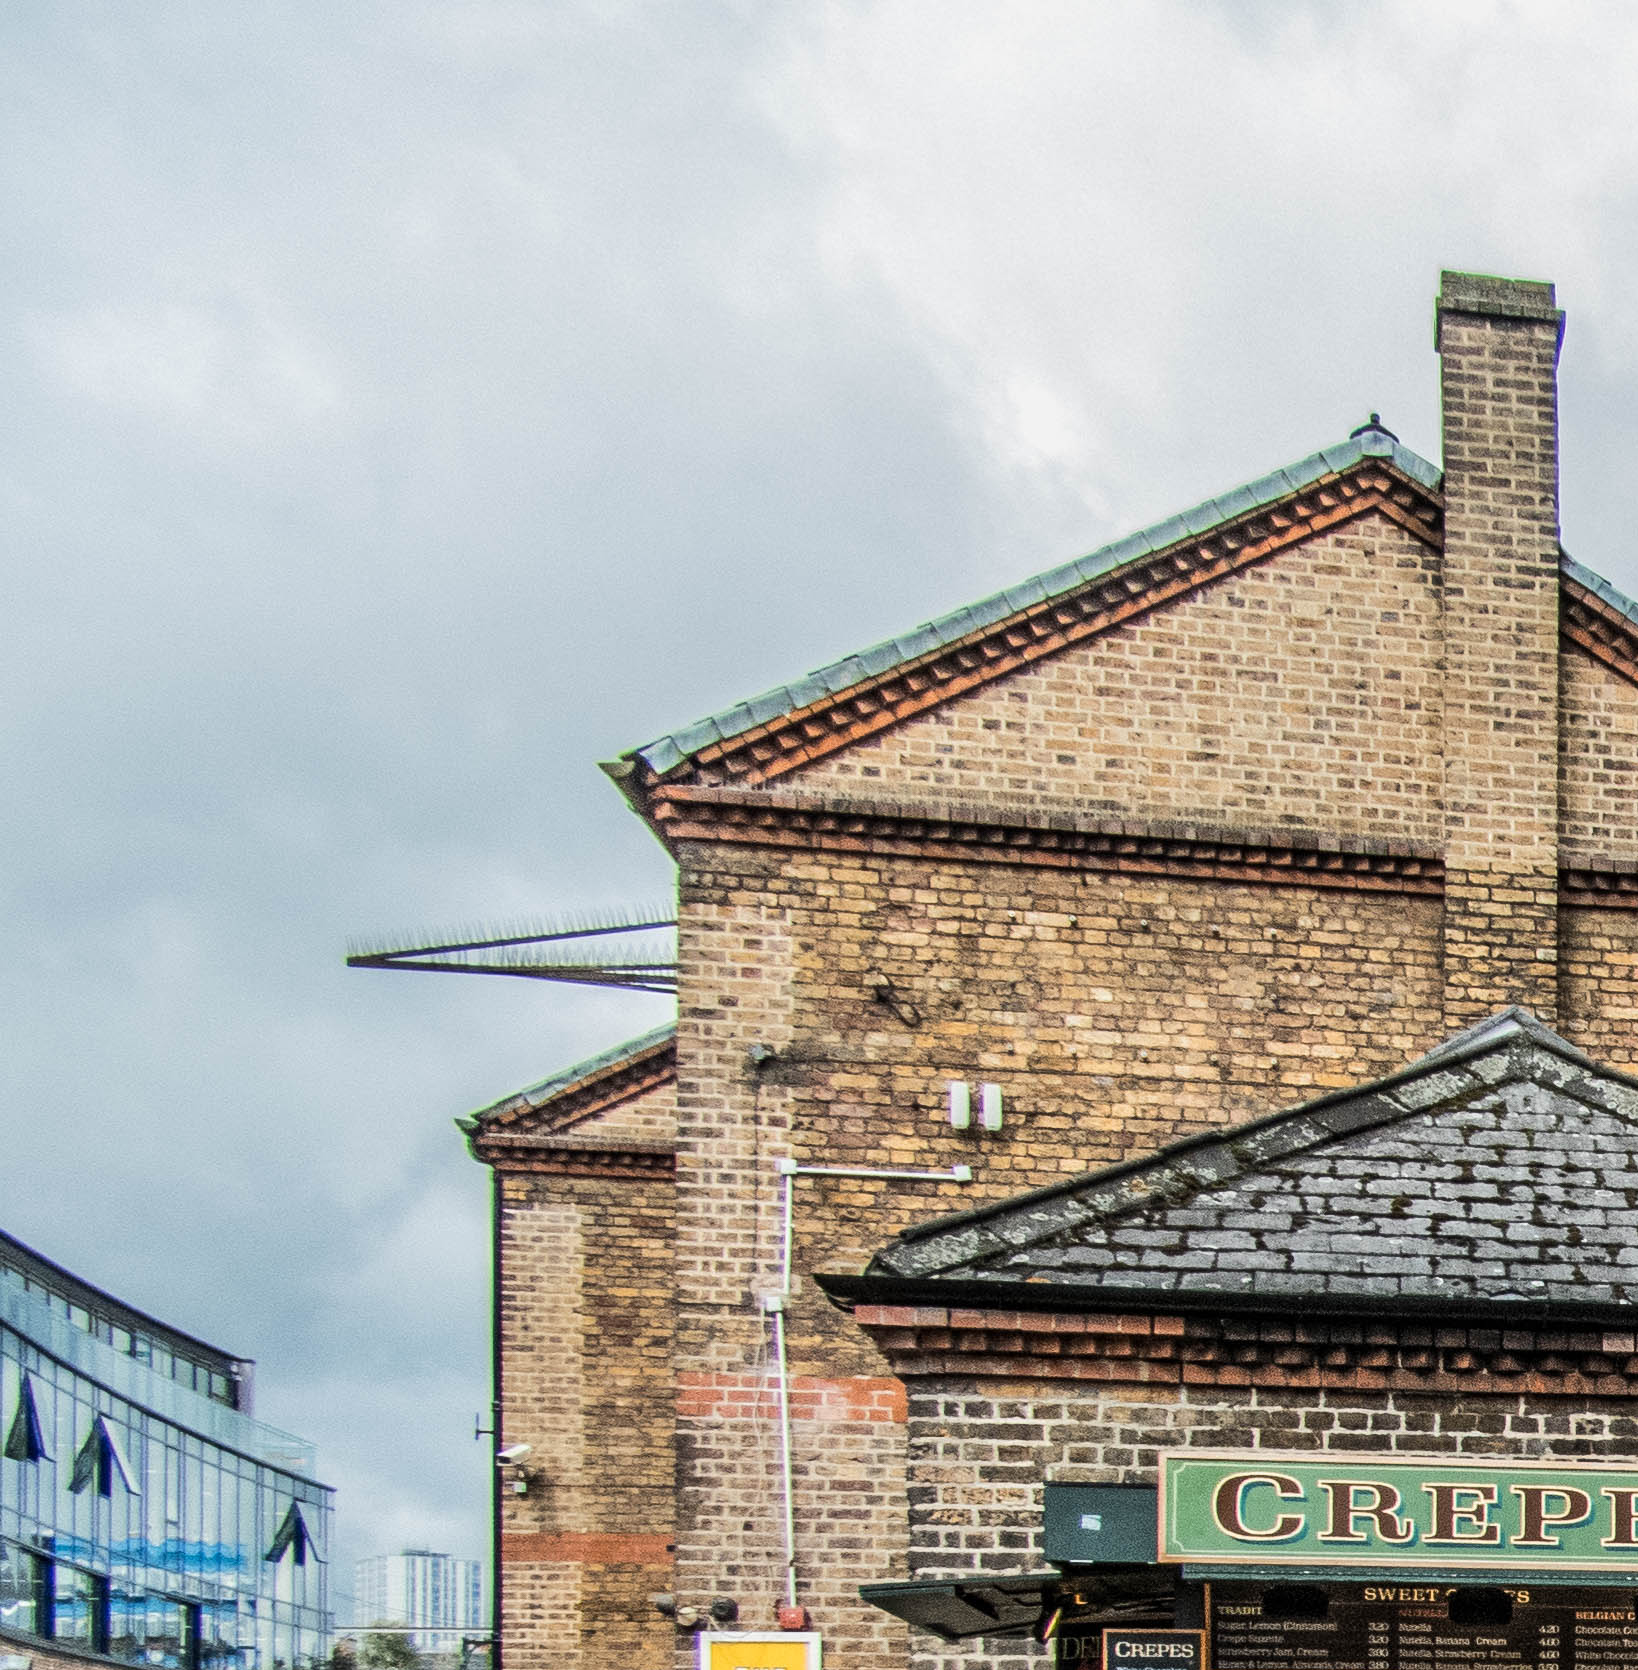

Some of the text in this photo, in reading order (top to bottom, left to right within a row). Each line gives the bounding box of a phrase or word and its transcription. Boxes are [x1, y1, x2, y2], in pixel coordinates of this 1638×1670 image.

[1364, 1587, 1439, 1602] SWEET
[1575, 1612, 1624, 1620] BELGIAN
[1115, 1641, 1194, 1658] CREPES
